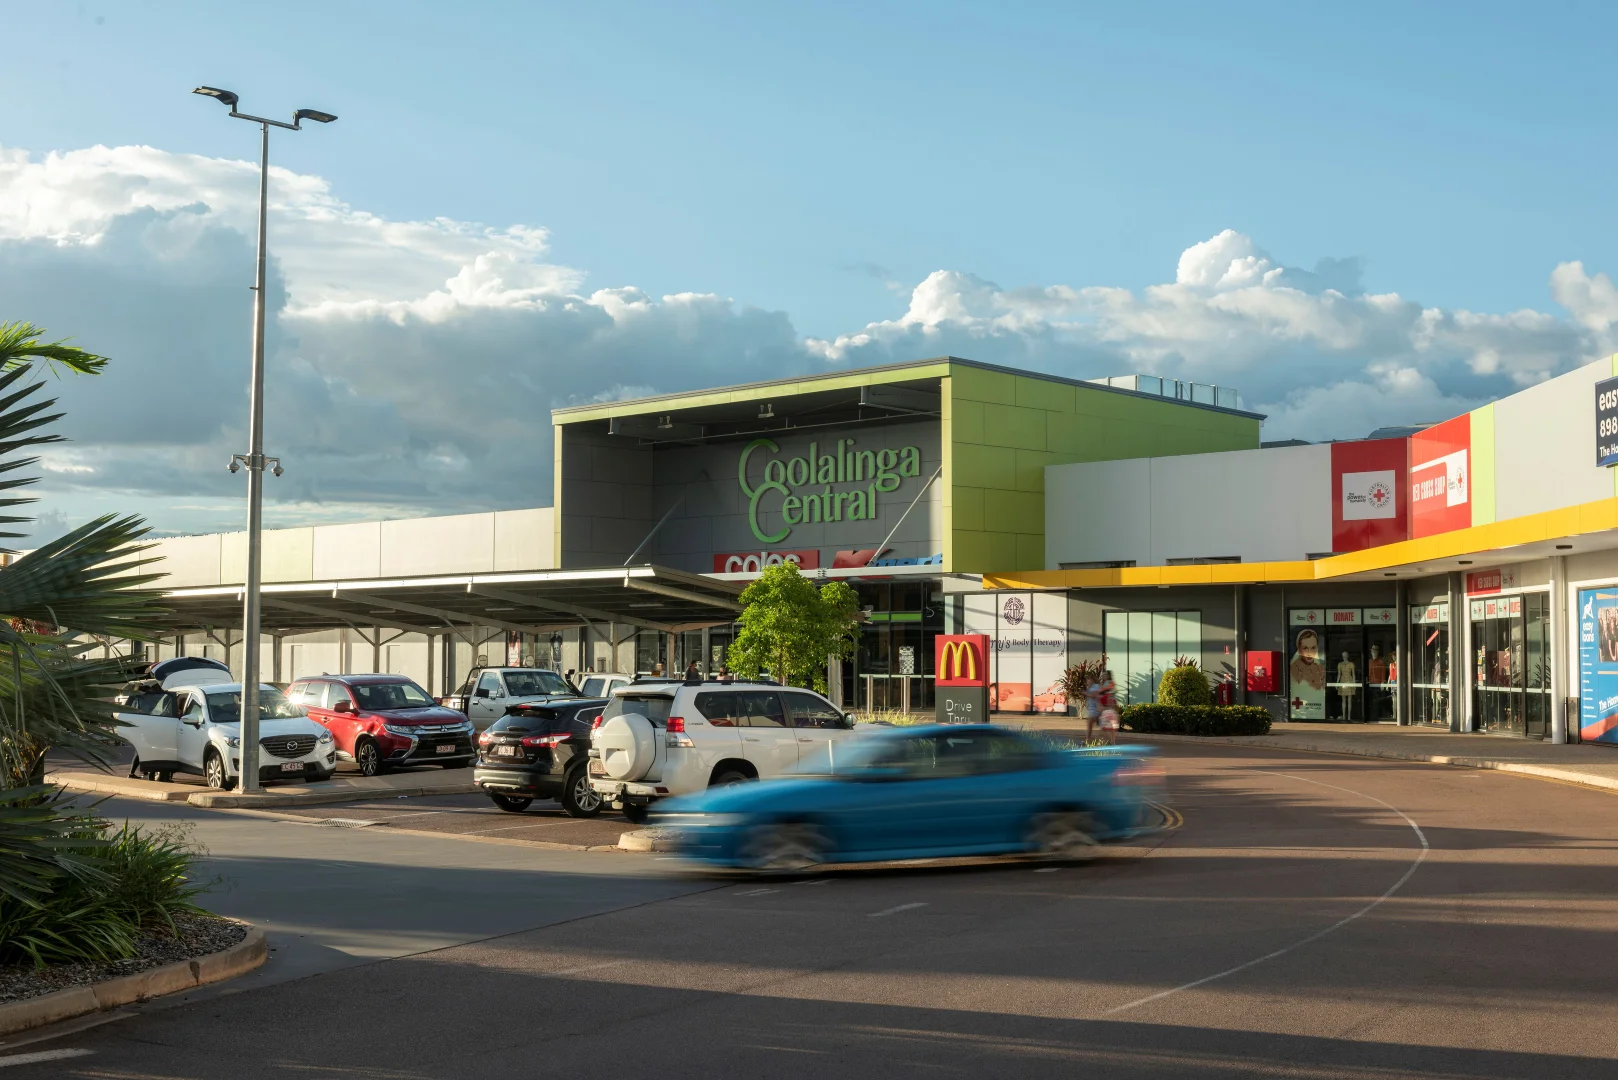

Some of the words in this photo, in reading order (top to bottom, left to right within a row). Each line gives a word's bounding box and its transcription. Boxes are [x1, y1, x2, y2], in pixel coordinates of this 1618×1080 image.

[1600, 445, 1610, 458] The
[739, 438, 920, 498] Coolalinga
[749, 481, 876, 543] Central
[1333, 611, 1354, 622] DONATE
[1012, 638, 1030, 647] Body
[1034, 638, 1062, 647] Therapy
[946, 699, 972, 712] Drive
[947, 712, 970, 723] Thru
